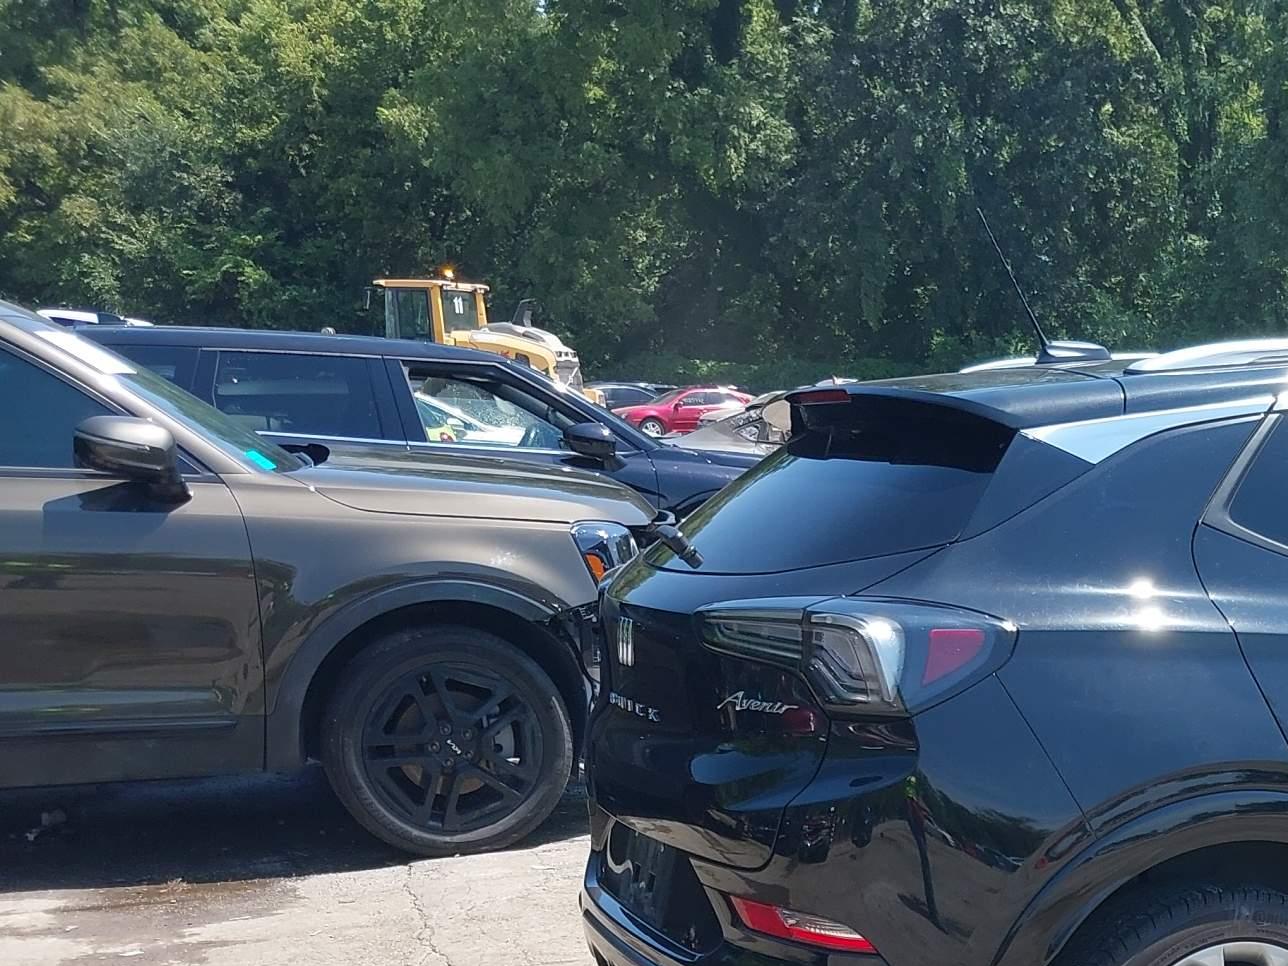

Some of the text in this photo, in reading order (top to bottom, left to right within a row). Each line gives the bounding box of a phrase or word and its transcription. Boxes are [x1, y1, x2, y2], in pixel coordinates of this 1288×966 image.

[453, 296, 464, 315] 11
[609, 692, 660, 722] BUICK
[716, 690, 799, 714] Avenir
